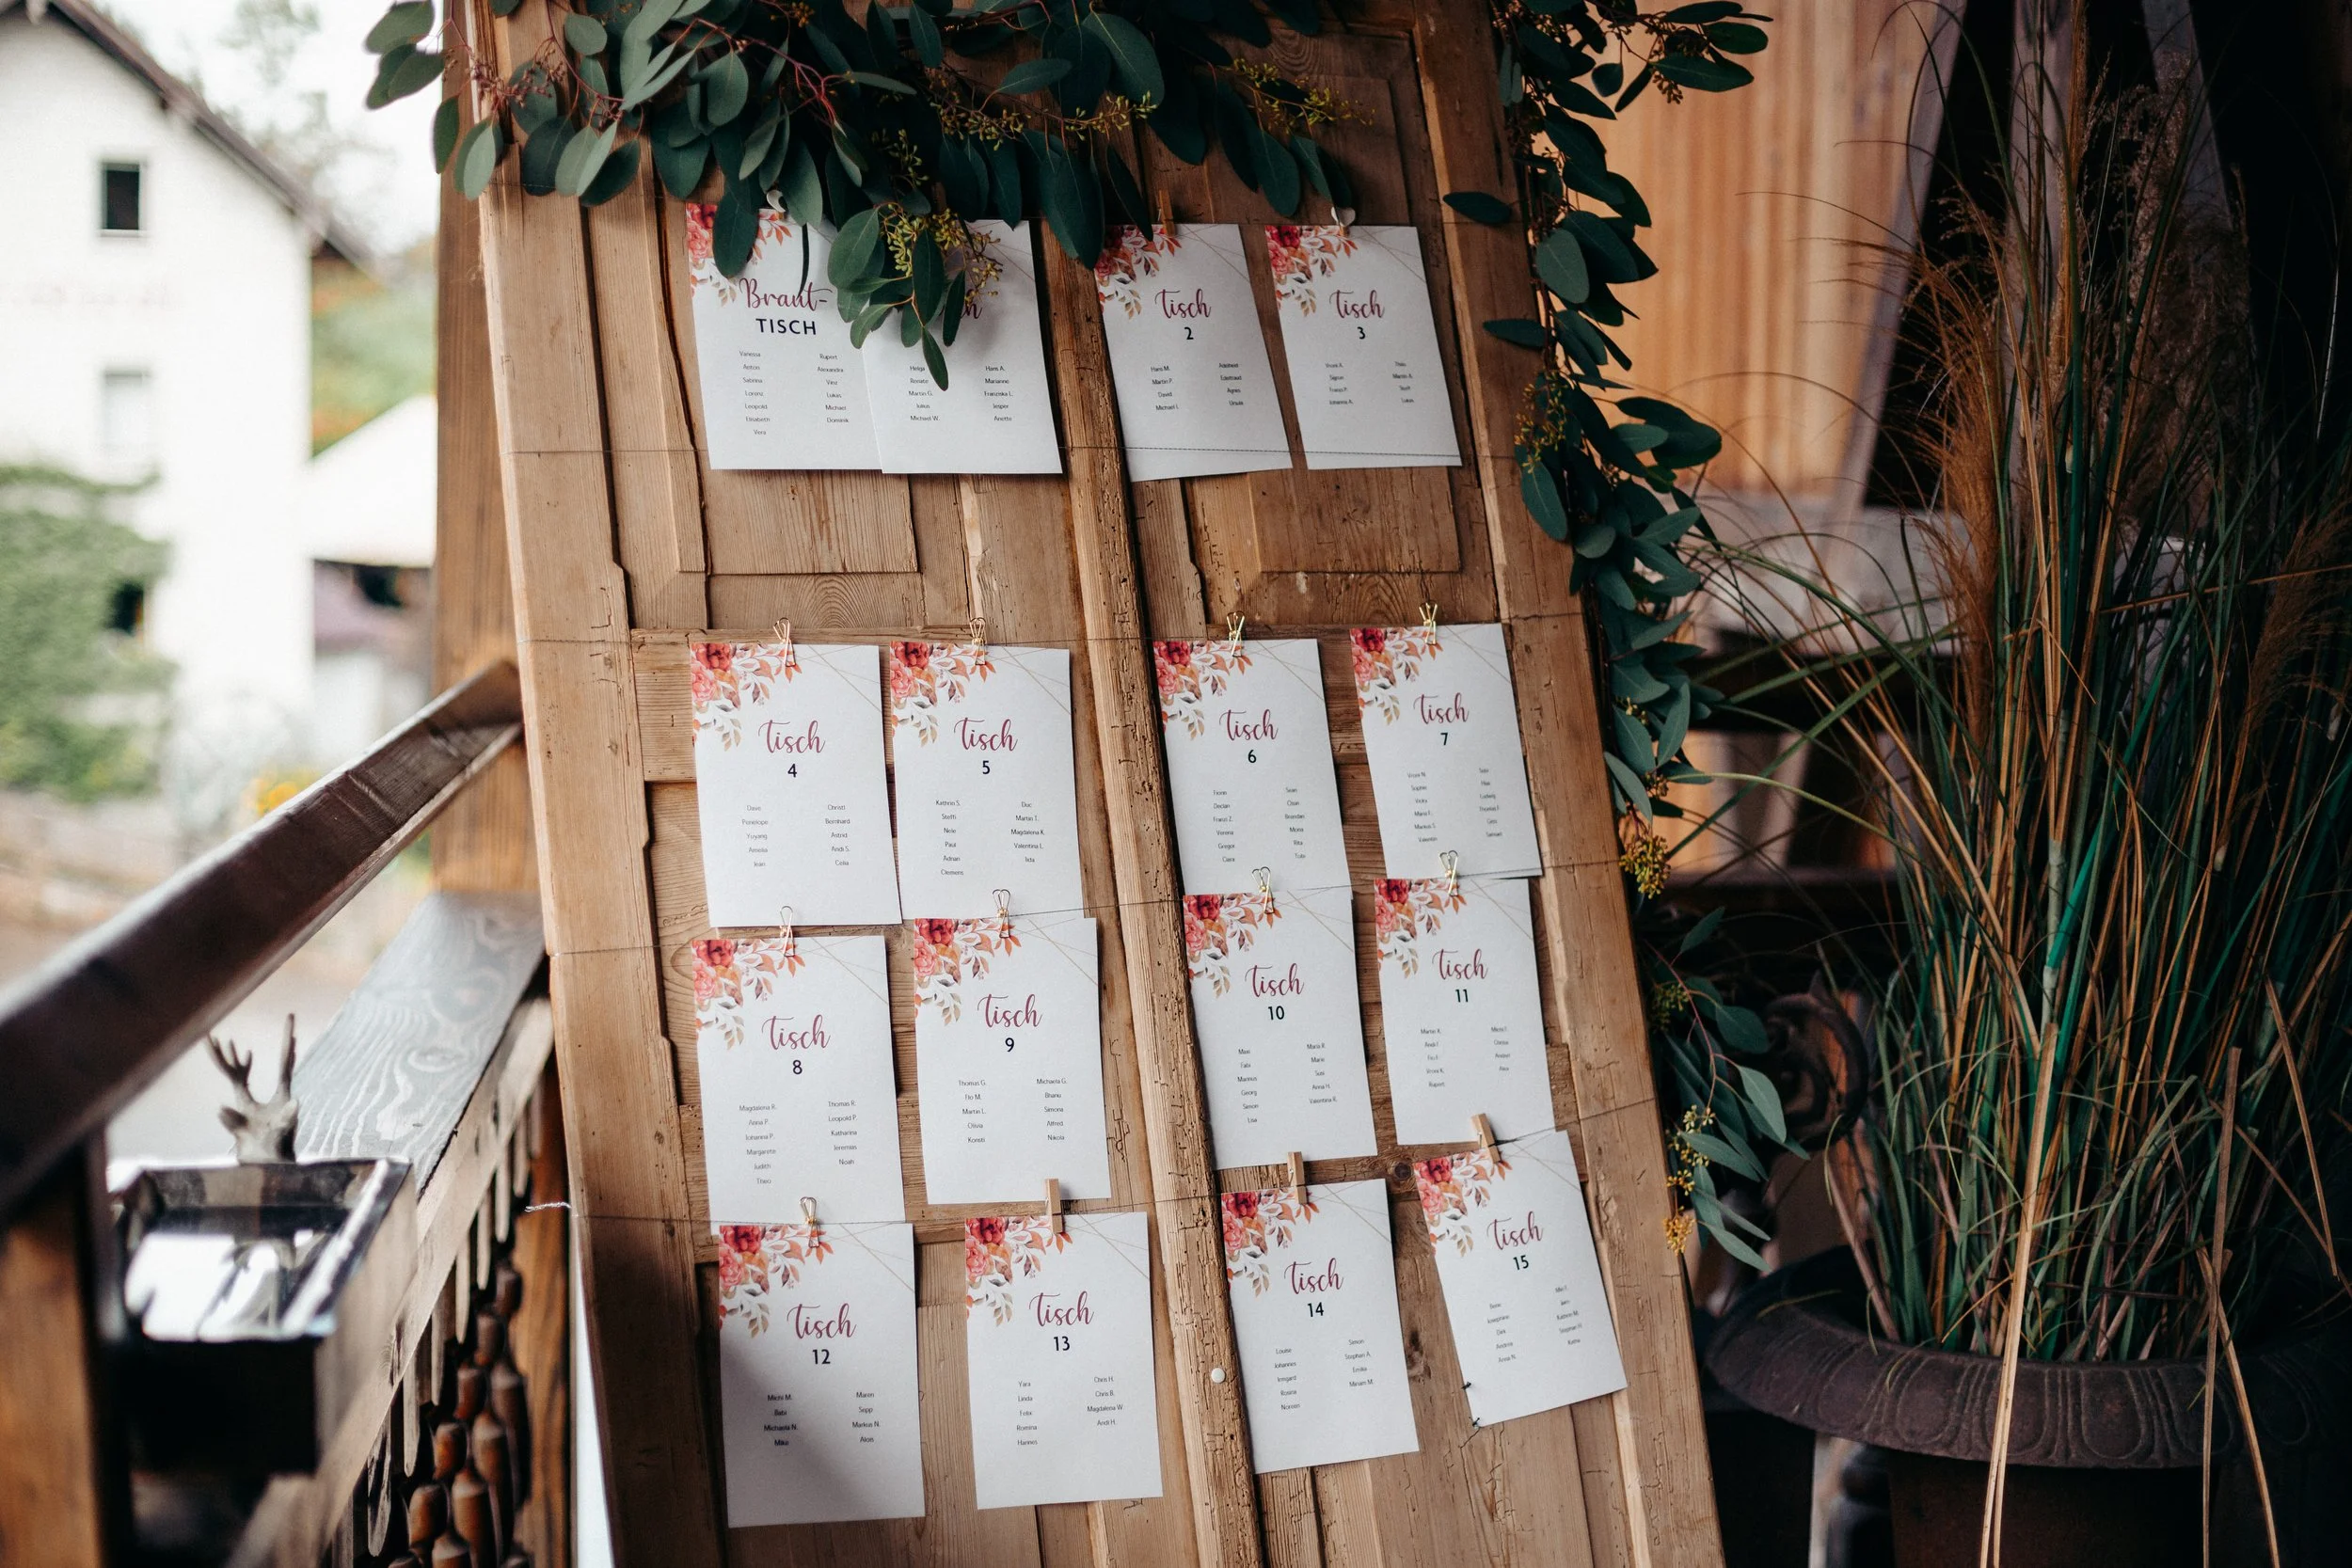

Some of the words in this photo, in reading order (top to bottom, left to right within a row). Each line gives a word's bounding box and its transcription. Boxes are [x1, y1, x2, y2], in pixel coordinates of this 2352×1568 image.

[739, 277, 833, 311] Braut-
[1154, 288, 1212, 319] Tisch
[1329, 290, 1385, 318] Tisch
[755, 318, 816, 335] TISCH
[1184, 326, 1194, 340] 2
[1357, 326, 1366, 340] 3
[1413, 692, 1469, 724] Tisch
[954, 718, 1018, 752] Tisch
[1219, 709, 1279, 741] Tisch
[758, 720, 825, 753] Tisch
[1440, 732, 1448, 746] 7
[982, 760, 990, 774] 5
[1248, 750, 1257, 763] 6
[787, 764, 797, 778] 4
[1432, 948, 1487, 980] Tisch
[1245, 963, 1304, 997] Tisch
[1455, 989, 1468, 1003] 11
[977, 993, 1042, 1028] Tisch
[1268, 1006, 1284, 1021] 10
[762, 1014, 831, 1050] Tisch
[1005, 1037, 1014, 1053] 9
[792, 1060, 803, 1075] 8
[1487, 1212, 1543, 1250] Tisch
[1513, 1255, 1529, 1270] 15
[1284, 1258, 1343, 1294] Tisch
[1029, 1291, 1094, 1326] Tisch
[1308, 1302, 1324, 1317] 14
[787, 1303, 856, 1339] Tisch
[1054, 1336, 1070, 1351] 13
[812, 1349, 831, 1365] 12
